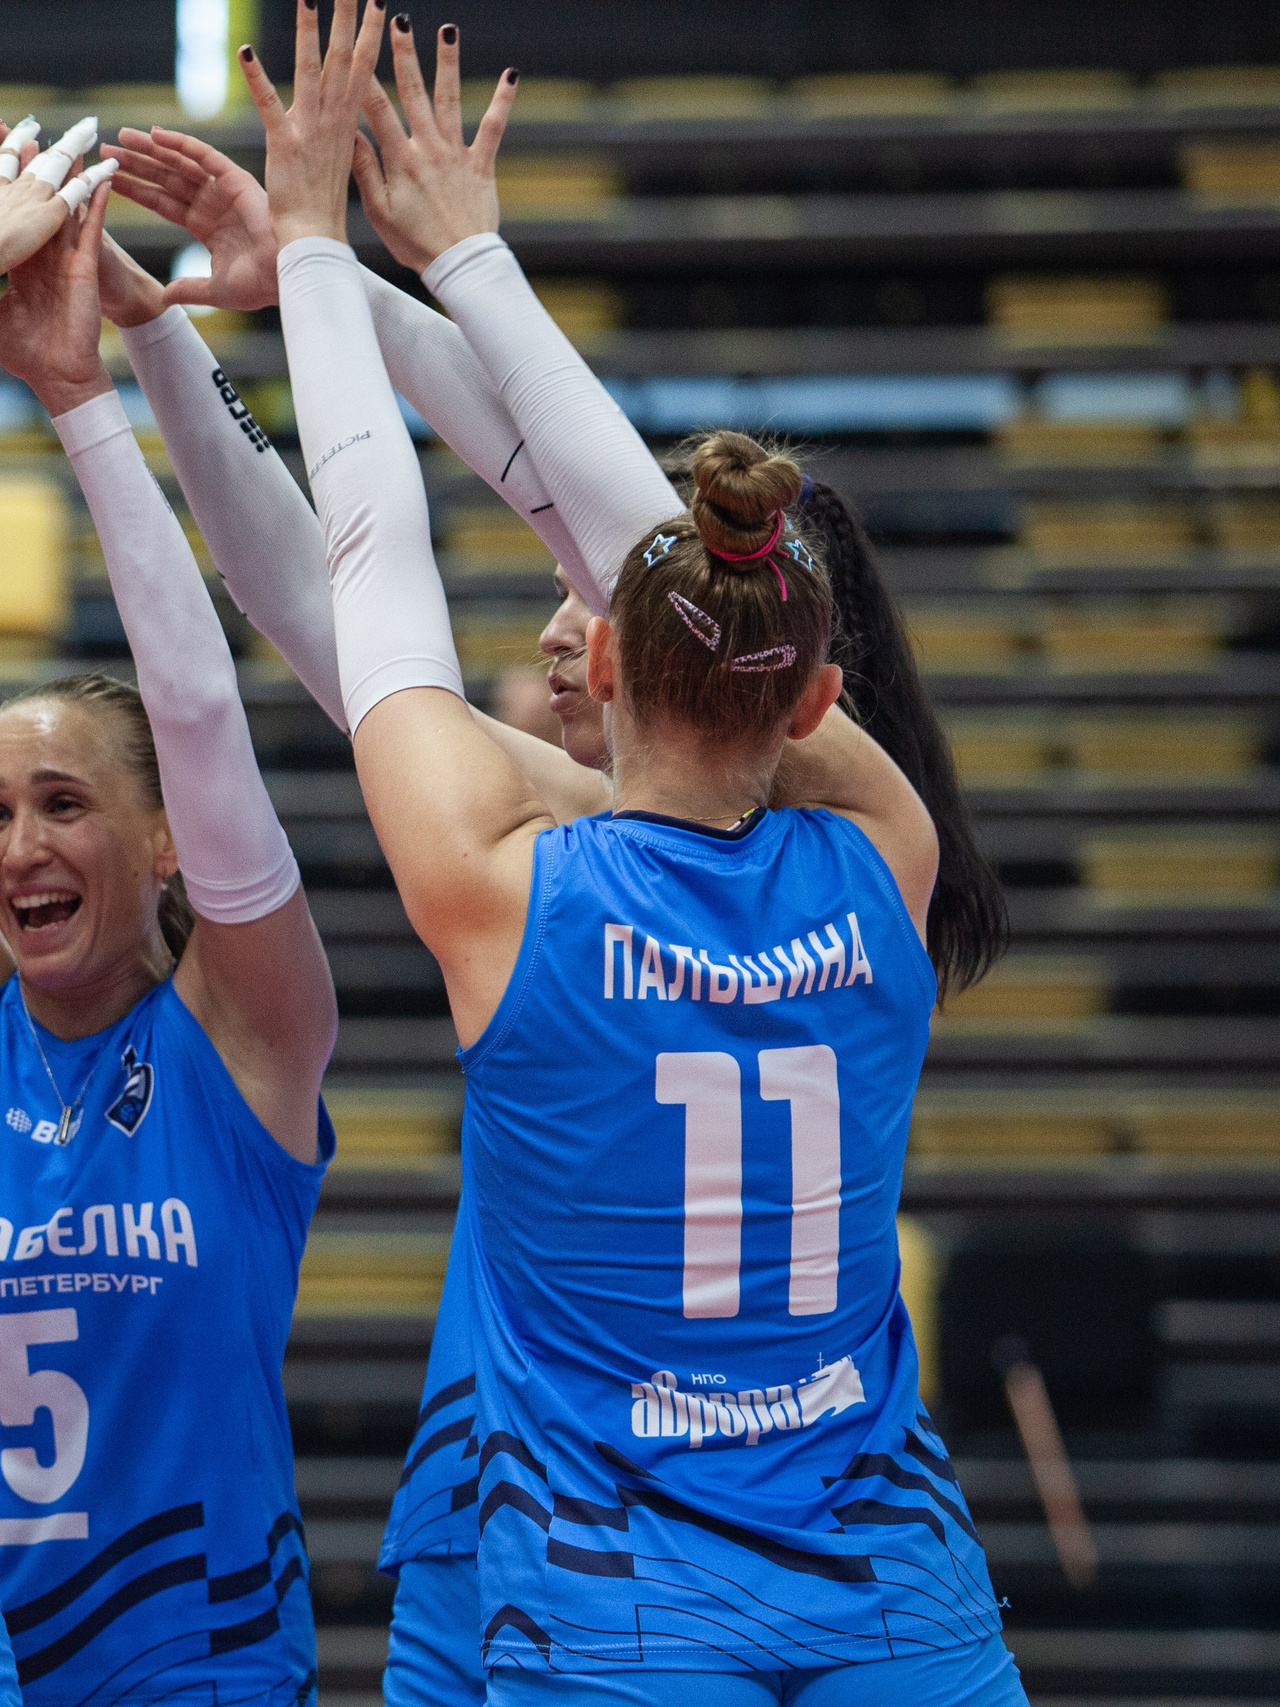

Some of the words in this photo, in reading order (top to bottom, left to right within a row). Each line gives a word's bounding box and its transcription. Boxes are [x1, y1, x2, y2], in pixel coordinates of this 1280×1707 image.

[604, 911, 873, 1004] ПАЛЬШИНА
[655, 1044, 842, 1319] 11
[691, 1373, 727, 1386] НПО
